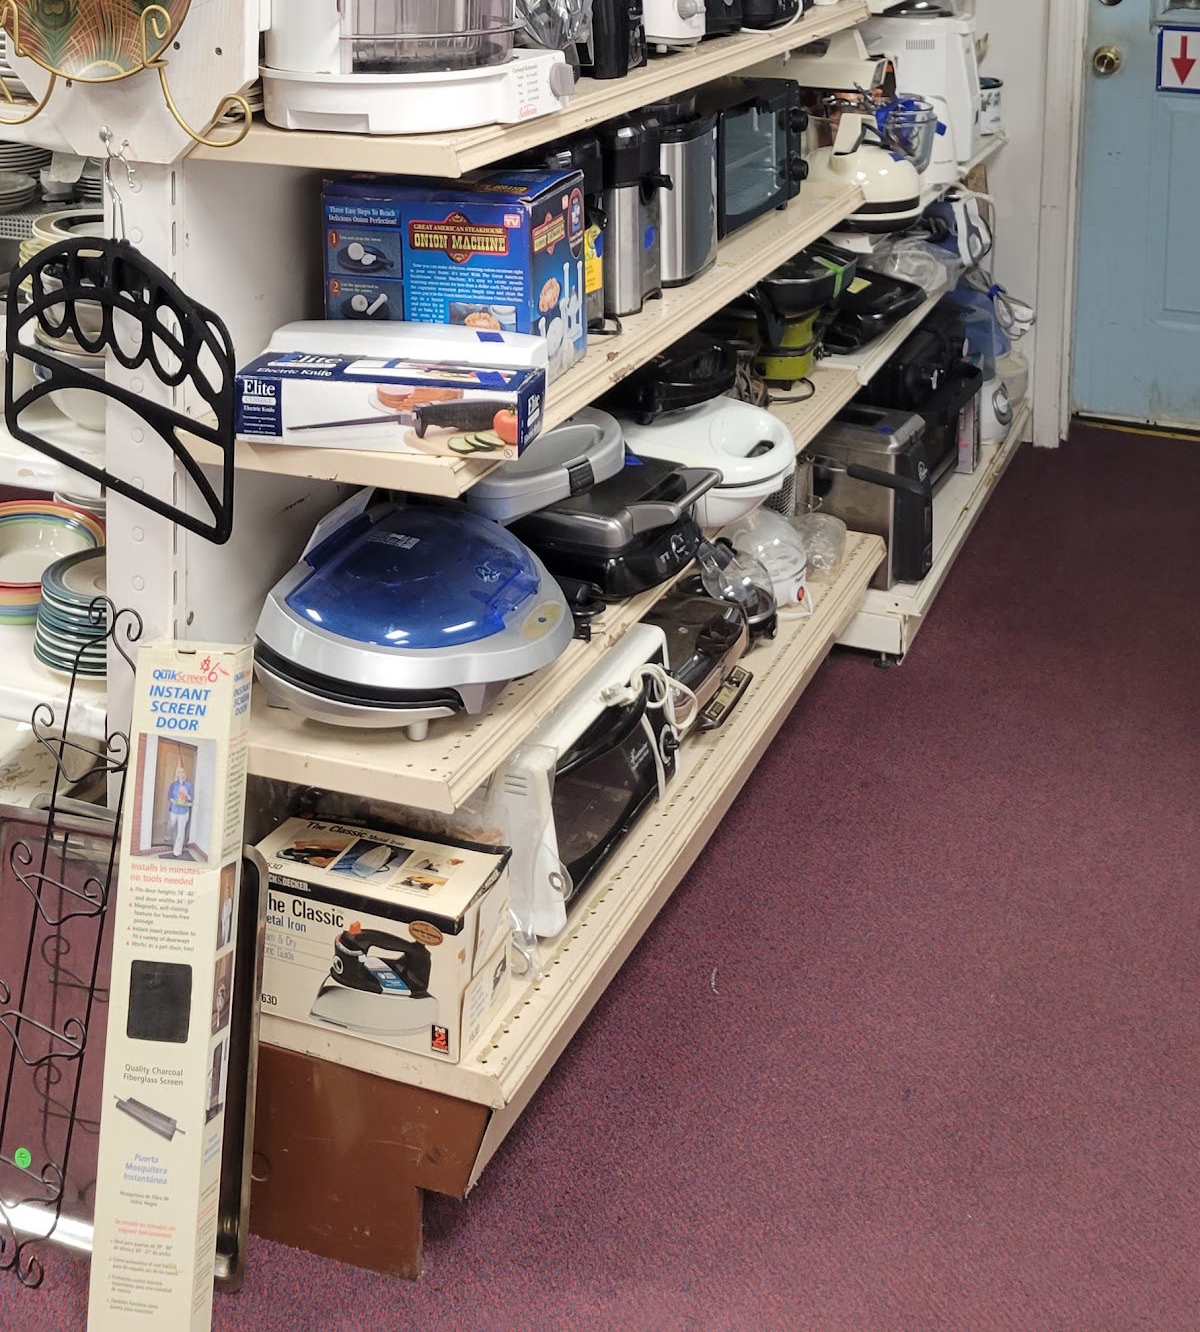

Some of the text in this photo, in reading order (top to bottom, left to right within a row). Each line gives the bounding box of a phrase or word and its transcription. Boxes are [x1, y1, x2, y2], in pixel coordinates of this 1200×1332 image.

[328, 214, 352, 222] Delicious
[353, 216, 368, 224] Onion
[380, 209, 396, 217] Reach
[465, 226, 504, 234] STEAKHOUSE
[414, 233, 506, 252] ONION MACHINE
[333, 281, 339, 292] 2
[256, 367, 332, 377] Electric Knife
[243, 379, 276, 396] Elite
[244, 397, 272, 405] CUISINE
[149, 685, 211, 701] INSTANT
[150, 700, 207, 716] SCREEN
[156, 716, 199, 731] DOOR
[307, 821, 327, 831] The
[329, 825, 367, 838] Classic
[131, 862, 157, 871] Installs
[159, 864, 167, 872] in
[266, 862, 283, 870] 63D
[143, 874, 162, 883] tools
[164, 877, 194, 885] needed
[268, 873, 309, 892] CK&DECKER
[157, 888, 176, 896] heights
[268, 892, 344, 928] he Classic
[266, 914, 307, 933] etal Iron
[261, 993, 277, 1006] 63D
[435, 1031, 446, 1046] 2
[124, 1063, 183, 1077] Quality Charcoal
[123, 1072, 184, 1086] Fiberglass Screen
[134, 1153, 159, 1164] Puerta
[124, 1162, 168, 1175] Mosquitera
[123, 1172, 168, 1185] Instantánea
